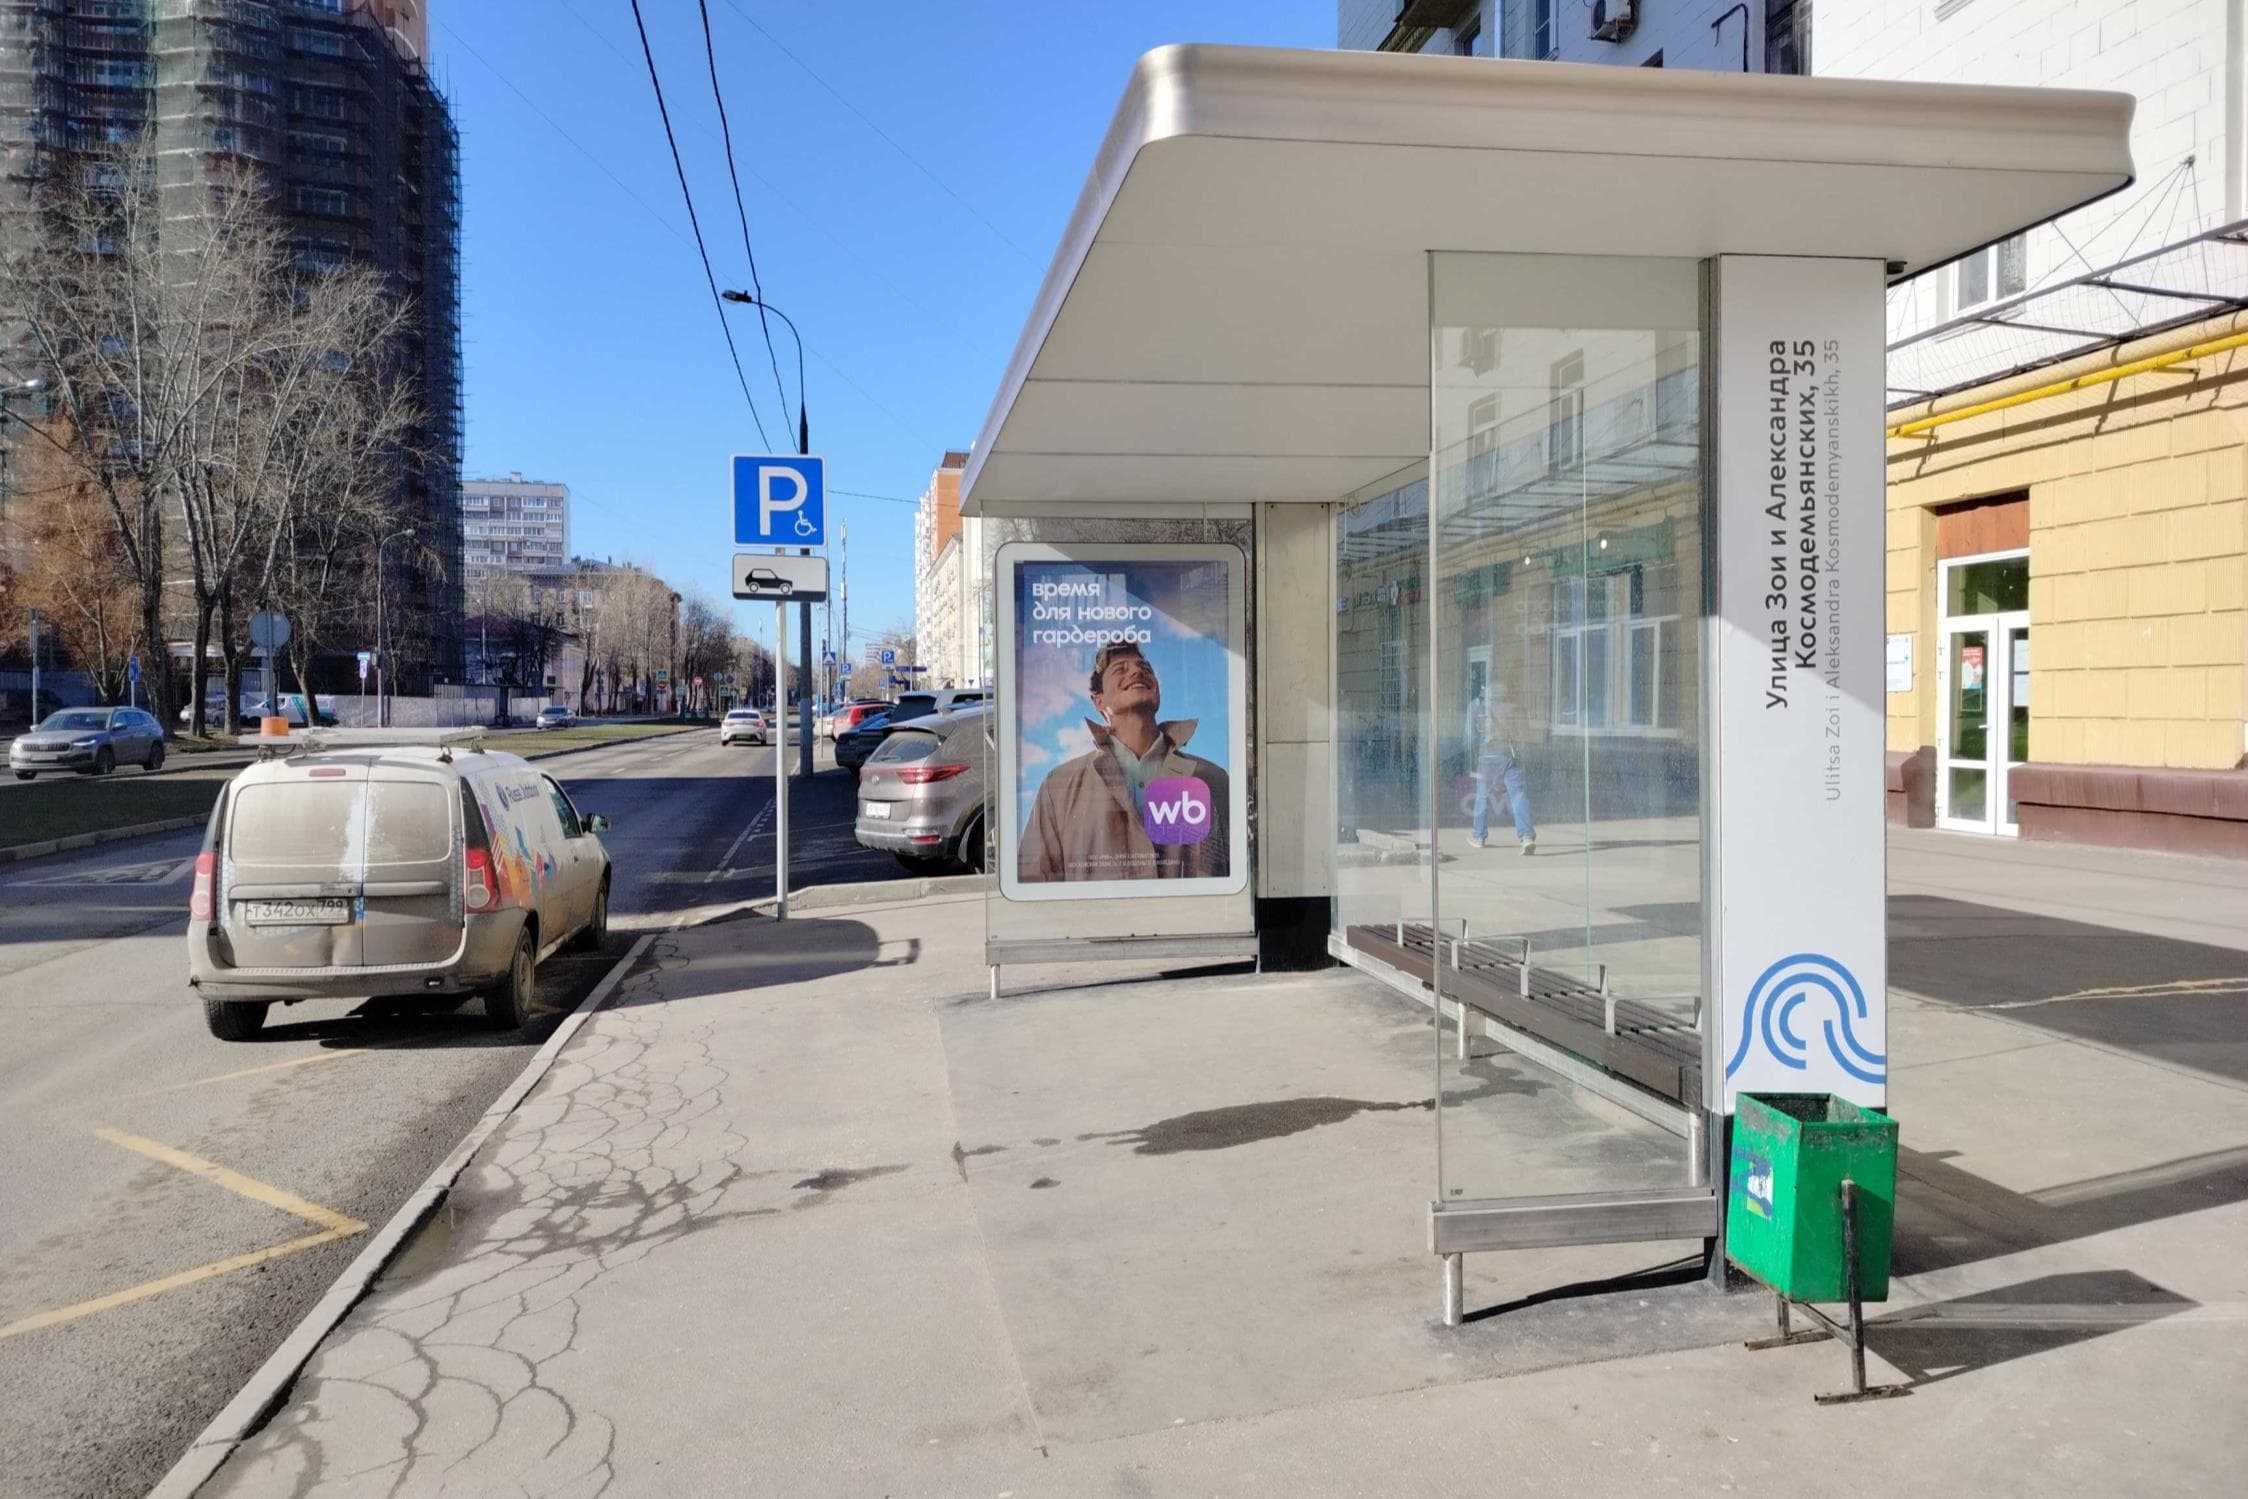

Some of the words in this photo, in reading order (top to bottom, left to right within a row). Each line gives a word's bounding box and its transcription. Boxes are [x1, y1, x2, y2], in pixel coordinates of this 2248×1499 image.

[1793, 339, 1815, 376] 35
[1823, 339, 1839, 364] 35
[1765, 340, 1791, 521] Александра
[1823, 370, 1842, 573] Kosmodemyanskikh,
[758, 465, 808, 536] P
[1771, 529, 1787, 546] и
[1794, 385, 1820, 668] Космодемьянских,
[1032, 582, 1100, 601] время
[1765, 556, 1788, 610] Зои
[1032, 601, 1071, 620] для
[1078, 606, 1152, 620] нового
[1032, 624, 1151, 648] гардероба
[1824, 579, 1840, 689] Aleksandra
[1765, 619, 1791, 710] Улица
[1825, 708, 1841, 738] Zoi
[1825, 744, 1841, 801] Ulitsa
[1147, 790, 1207, 825] wb
